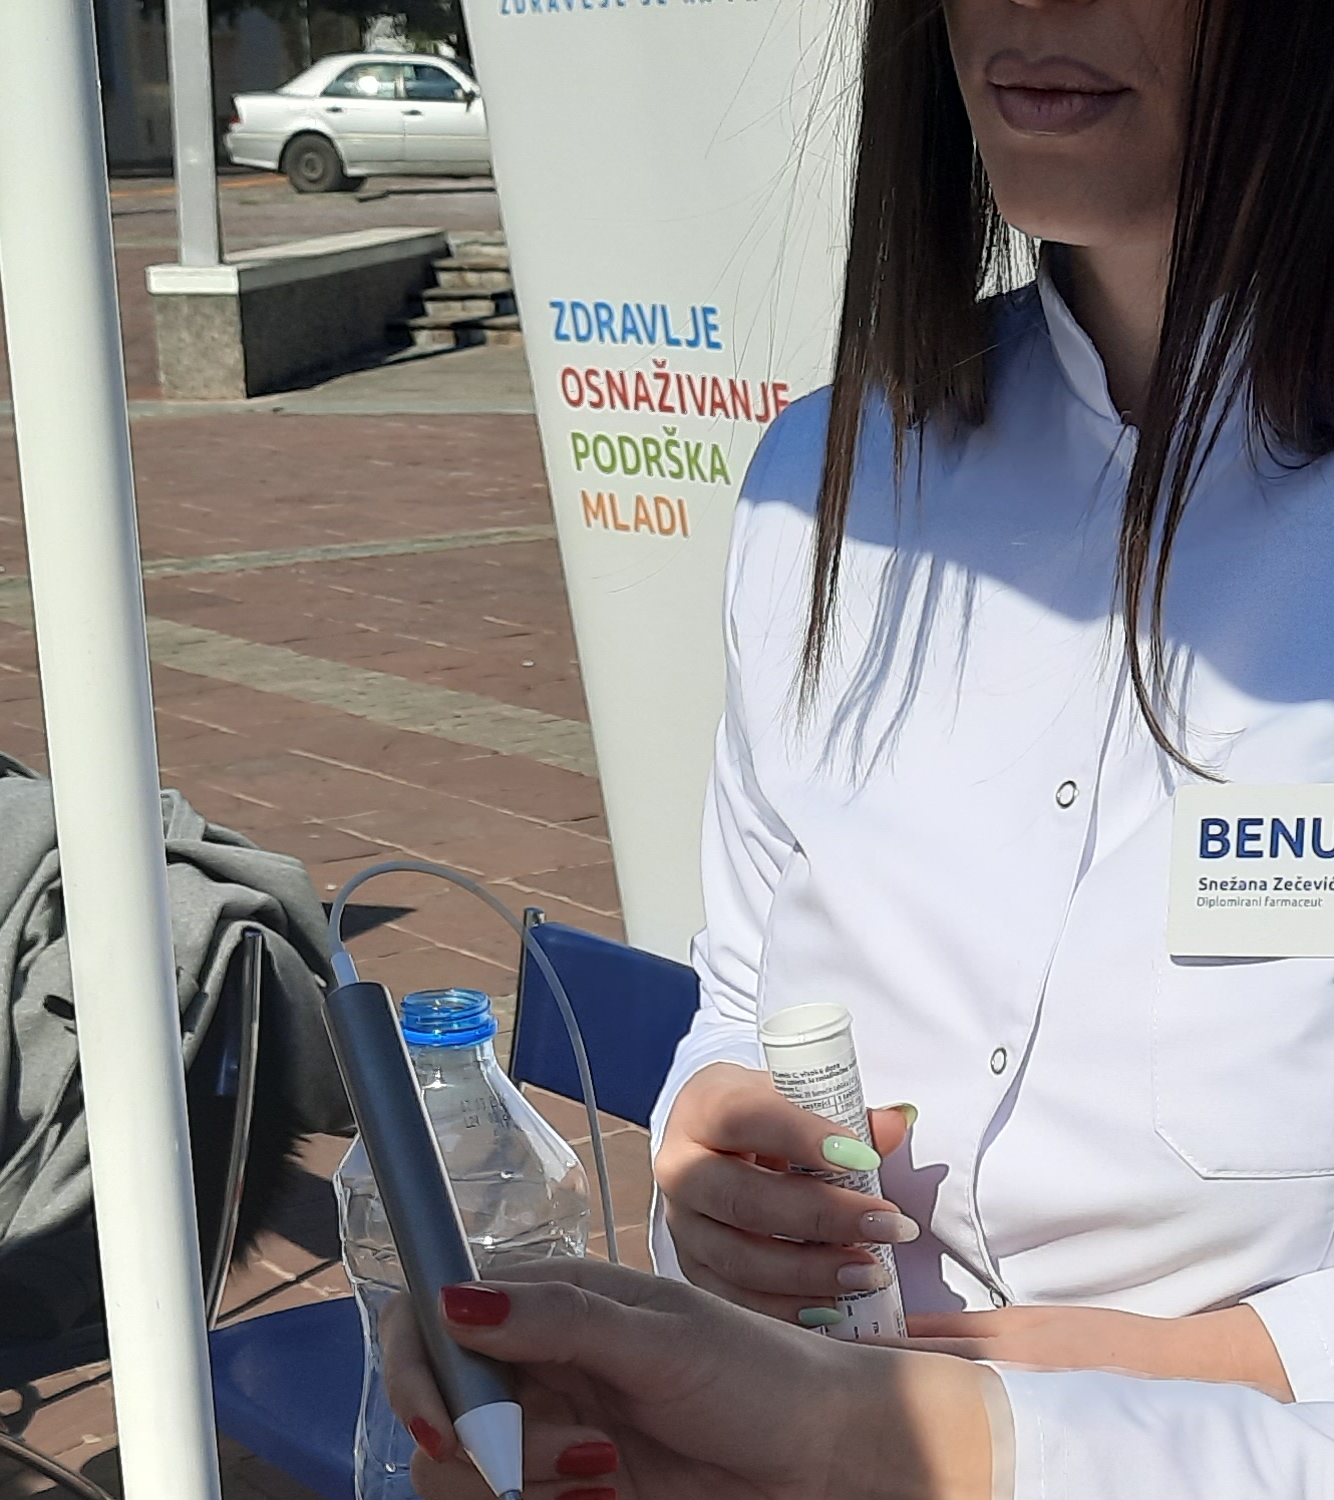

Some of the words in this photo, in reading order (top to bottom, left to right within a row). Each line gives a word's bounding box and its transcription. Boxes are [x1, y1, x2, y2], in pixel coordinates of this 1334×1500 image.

[549, 300, 723, 351] ZDRAVLJE
[560, 359, 791, 423] OSNAŽIVANJE
[571, 426, 731, 485] PODRŠKA
[581, 490, 690, 537] MLADI
[1197, 896, 1262, 909] Diplomirani
[1264, 896, 1323, 908] farmaceut
[1198, 875, 1268, 892] Snežana
